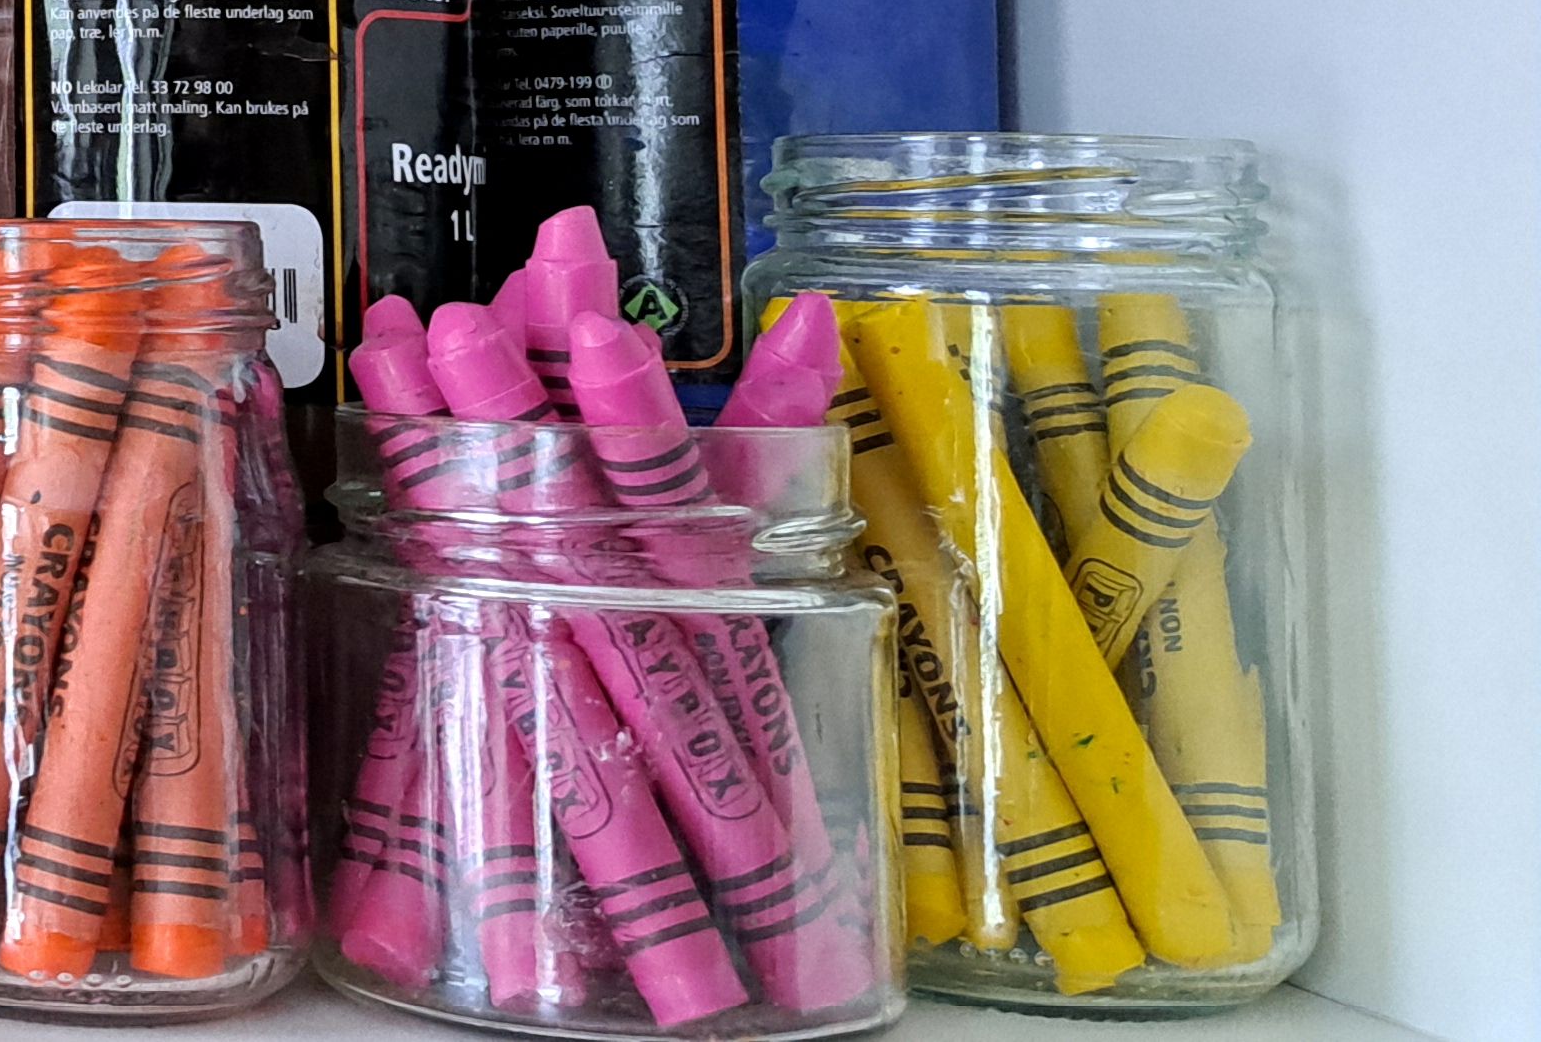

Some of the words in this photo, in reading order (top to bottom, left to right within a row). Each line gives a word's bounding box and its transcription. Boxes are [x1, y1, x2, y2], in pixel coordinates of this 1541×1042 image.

[51, 8, 74, 19] Kan
[77, 8, 139, 20] anvendes
[143, 4, 159, 22] på
[163, 5, 180, 19] de
[185, 4, 221, 19] fleste
[226, 5, 283, 23] underlag
[287, 9, 313, 20] som
[51, 28, 75, 41] pap,
[80, 27, 105, 40] træ,
[541, 22, 597, 40] paperille,
[51, 81, 72, 94] NO
[77, 80, 122, 94] Lekolar
[152, 81, 168, 94] 33
[174, 81, 189, 94] 72
[195, 81, 212, 94] 98
[216, 81, 233, 94] 00
[534, 76, 592, 90] 0479-199
[51, 100, 122, 114] Vannbasert
[161, 101, 212, 117] maling.
[216, 101, 242, 114] Kan
[246, 101, 289, 115] brukes
[293, 101, 309, 119] på
[565, 98, 590, 107] som
[70, 120, 104, 134] fleste
[107, 120, 170, 136] underlag.
[533, 114, 548, 130] på
[551, 114, 566, 127] de
[570, 112, 603, 126] flesta
[671, 115, 699, 126] som
[519, 134, 539, 145] lera
[391, 142, 486, 196] Readym
[451, 210, 459, 241] 1
[467, 210, 475, 241] L
[1159, 598, 1183, 652] NON
[724, 615, 800, 776] RAYONS
